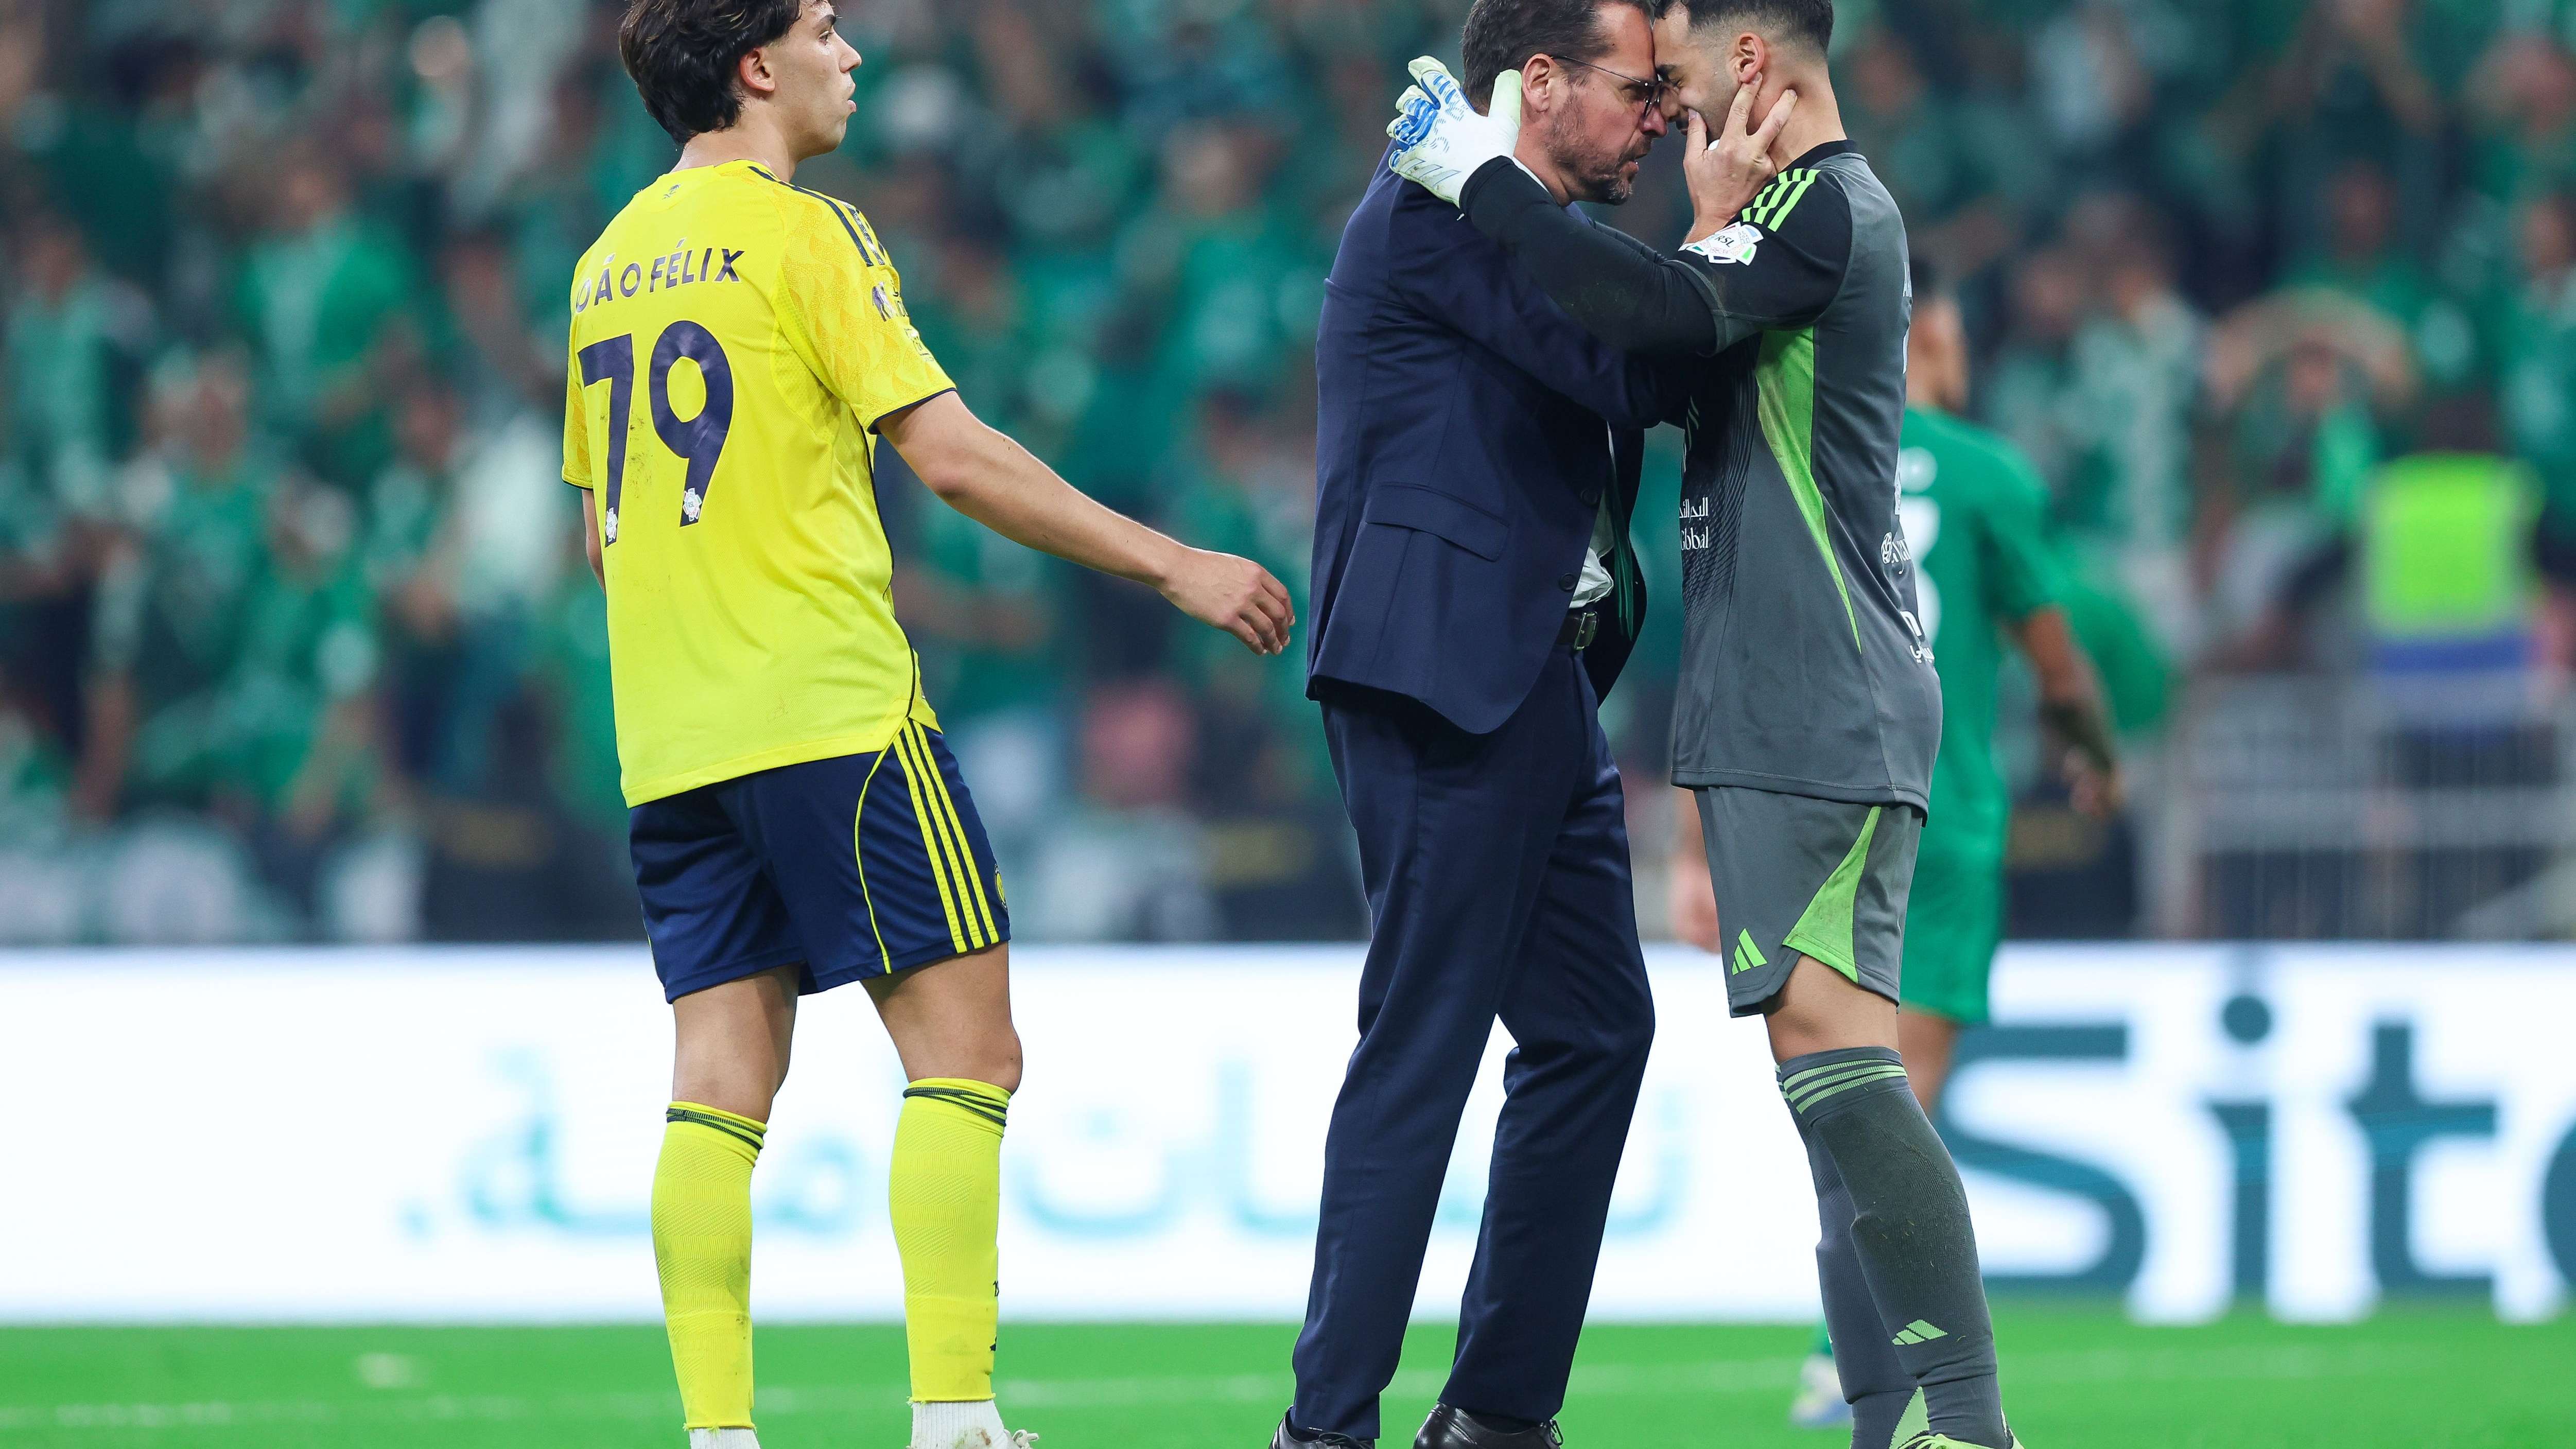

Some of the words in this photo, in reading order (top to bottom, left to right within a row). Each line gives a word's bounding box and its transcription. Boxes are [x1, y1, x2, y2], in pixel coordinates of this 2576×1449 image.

[576, 252, 641, 313] OÃO
[649, 237, 745, 293] FÉLIX
[1715, 235, 1735, 247] RSL
[577, 320, 735, 548] 79
[1930, 993, 2576, 1291] Sit
